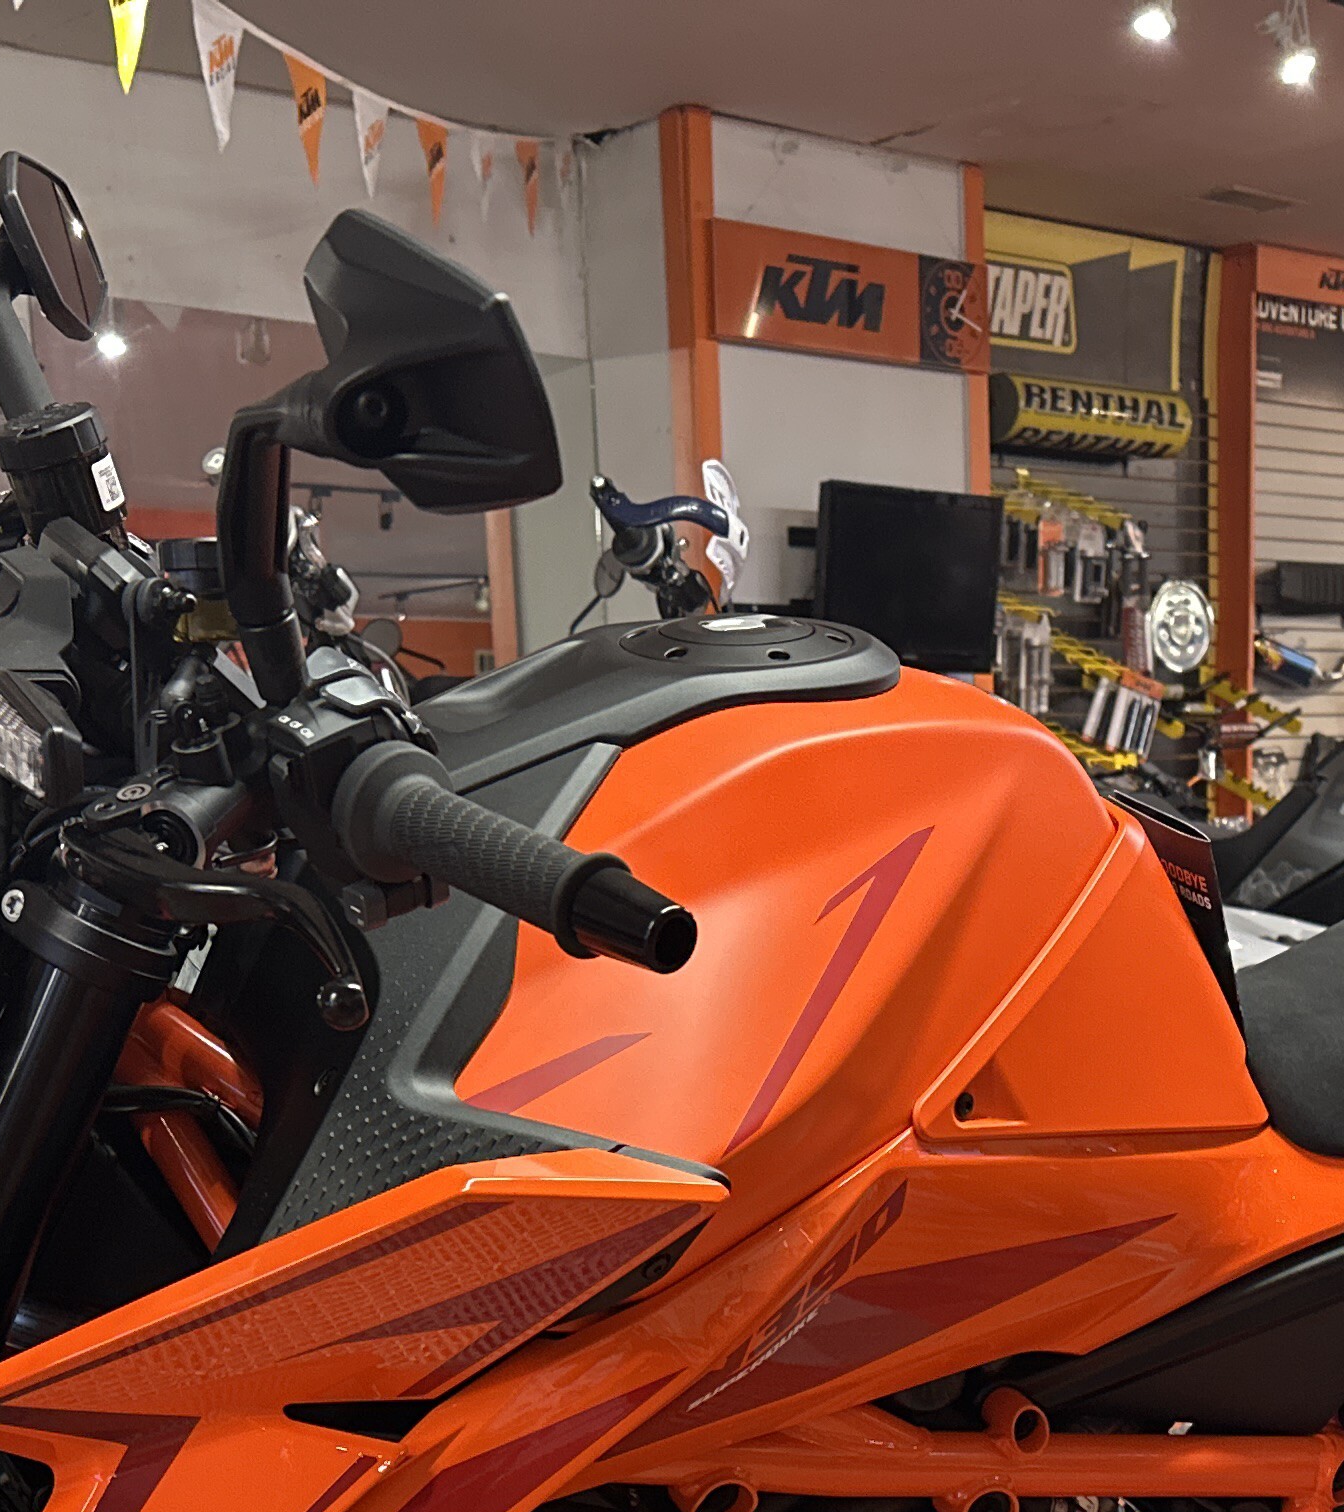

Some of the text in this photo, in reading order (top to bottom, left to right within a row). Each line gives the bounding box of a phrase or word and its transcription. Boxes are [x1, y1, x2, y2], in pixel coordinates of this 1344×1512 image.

[755, 253, 887, 333] KTM
[1256, 297, 1338, 331] DVENTURE
[1022, 383, 1188, 432] RENTHAL
